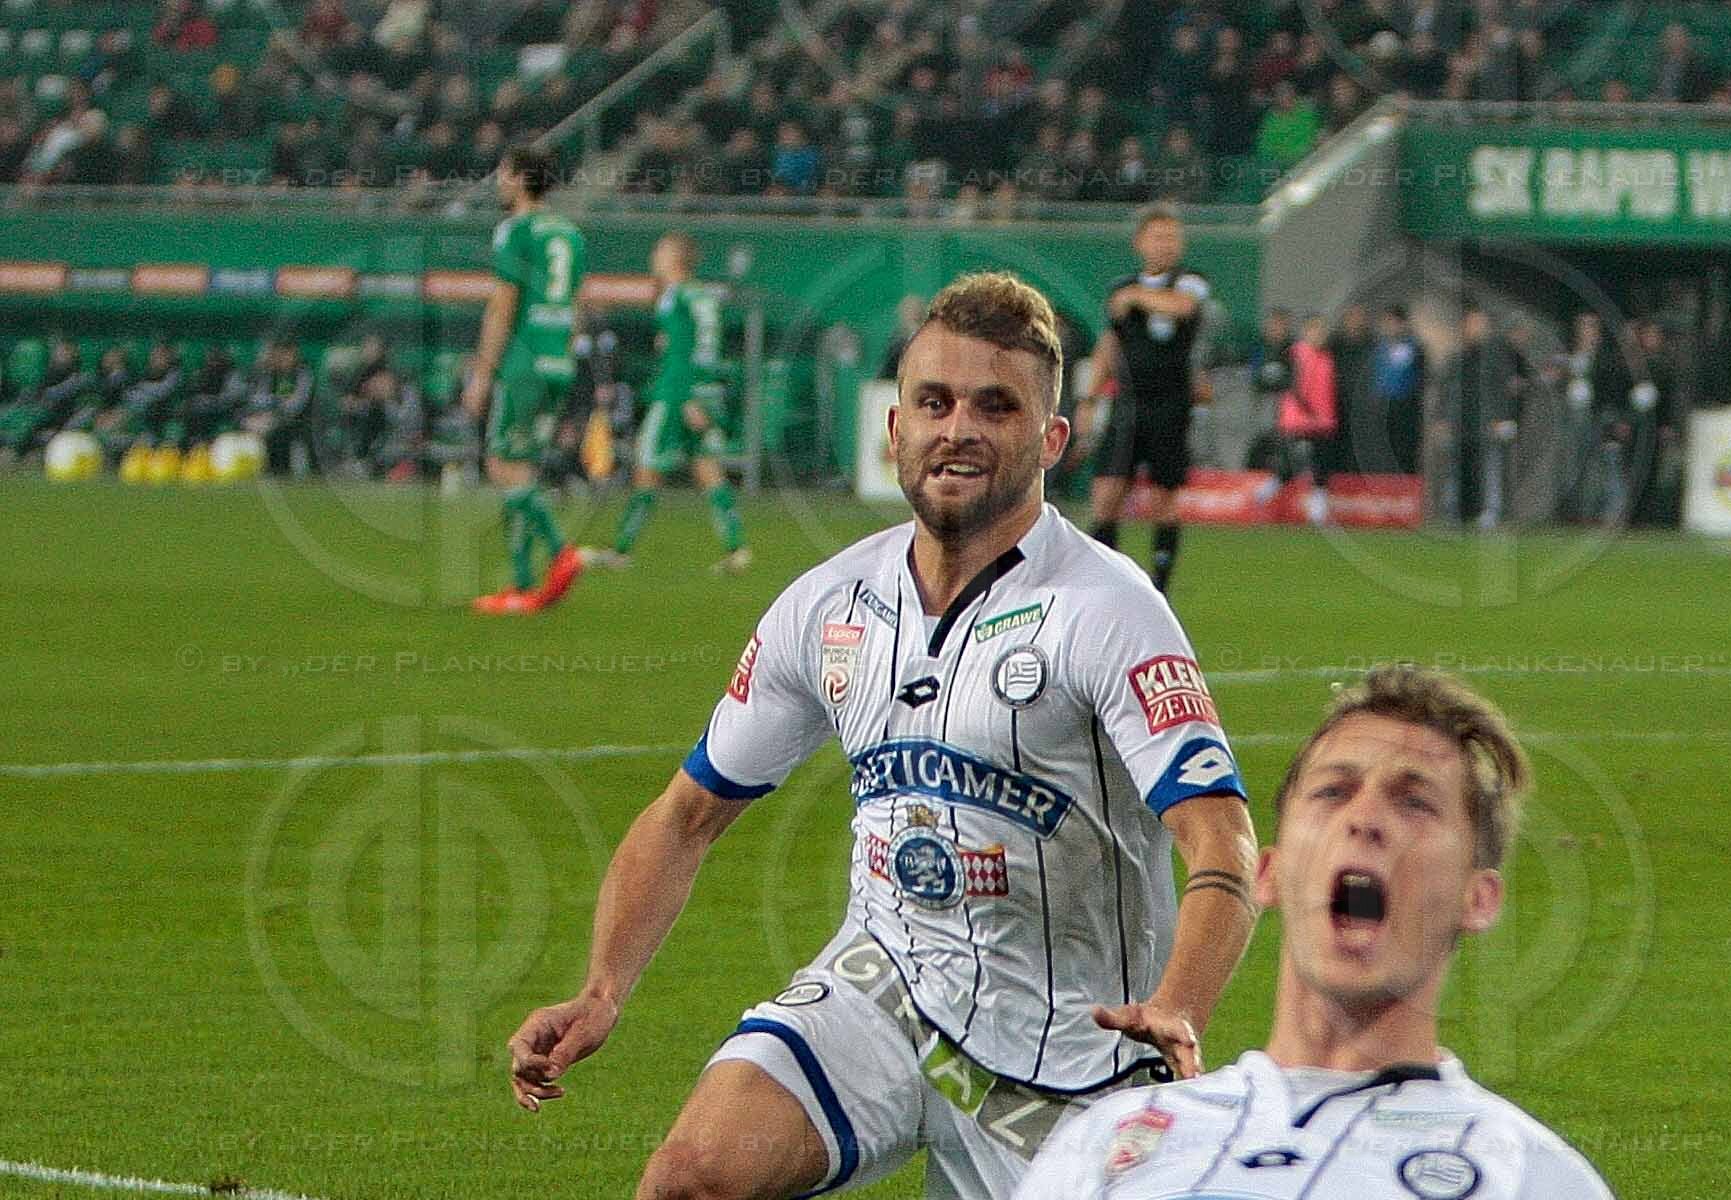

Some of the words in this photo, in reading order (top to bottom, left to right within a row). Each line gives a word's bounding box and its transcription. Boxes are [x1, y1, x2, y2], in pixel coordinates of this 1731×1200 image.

[1465, 146, 1534, 215] SK
[1541, 148, 1678, 218] RAPID
[994, 608, 1042, 637] GRAWE
